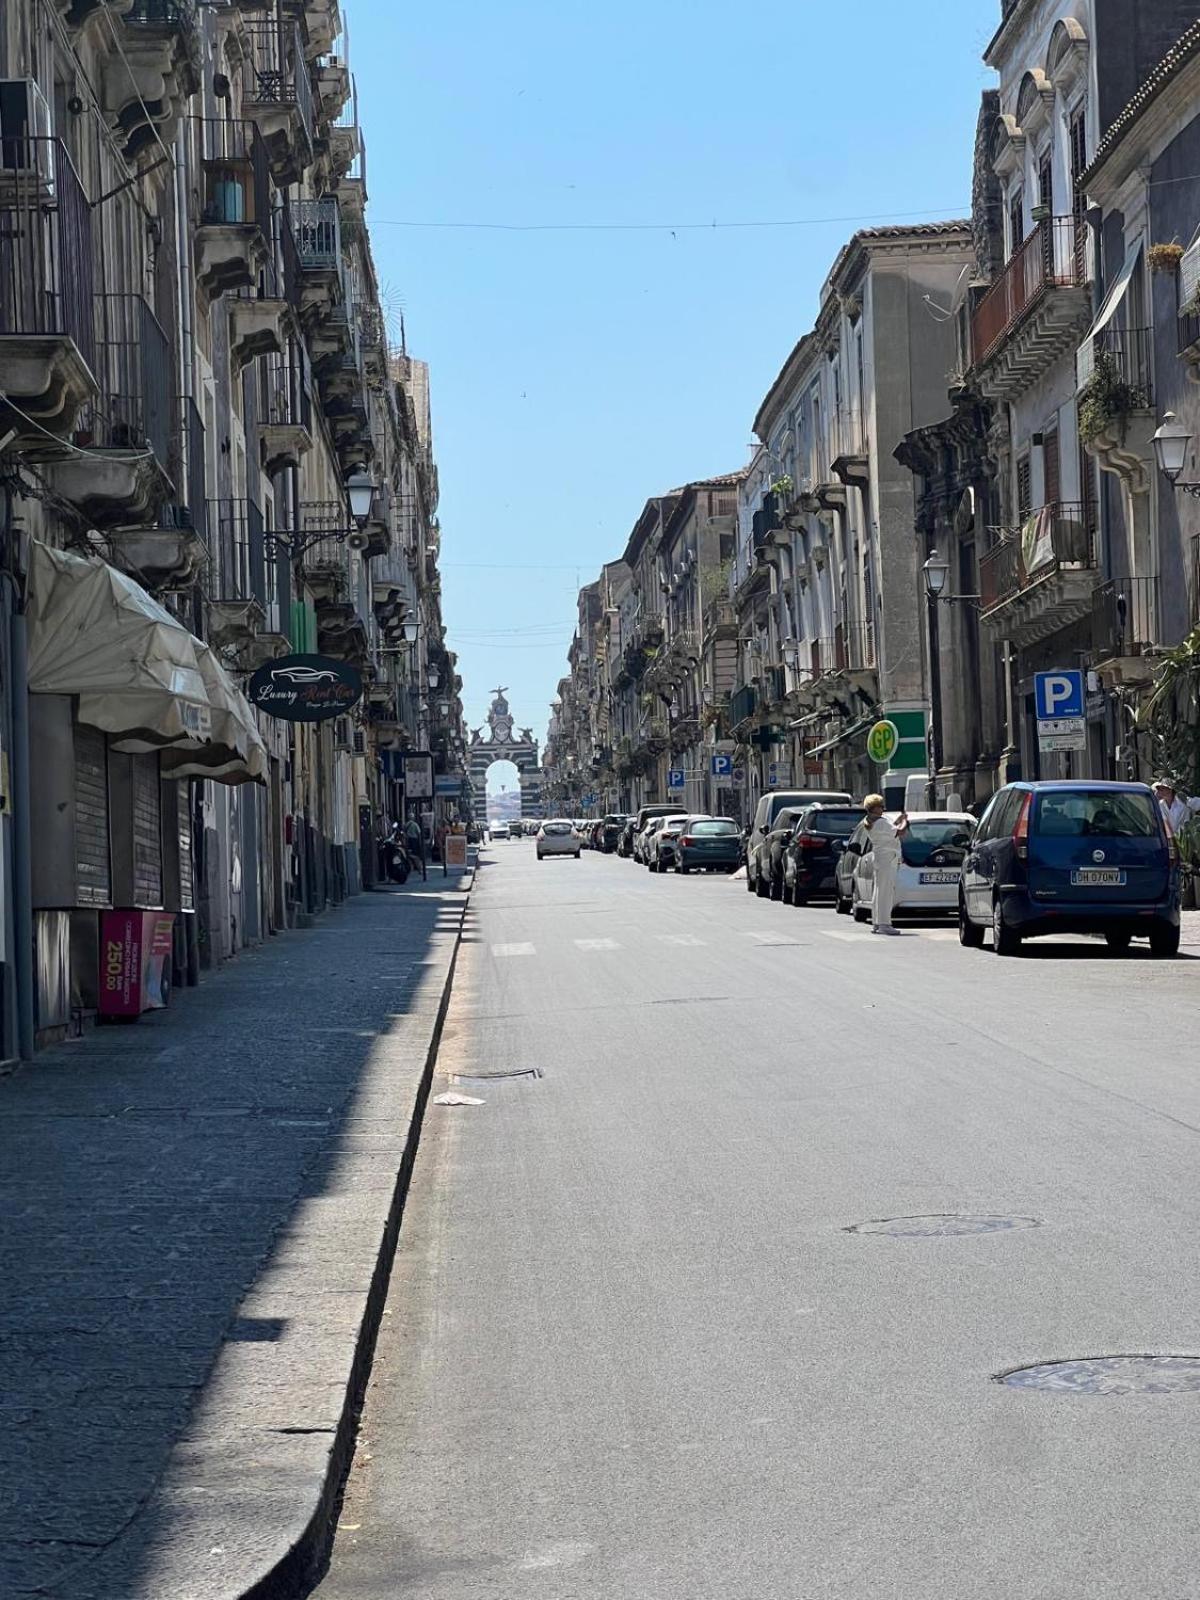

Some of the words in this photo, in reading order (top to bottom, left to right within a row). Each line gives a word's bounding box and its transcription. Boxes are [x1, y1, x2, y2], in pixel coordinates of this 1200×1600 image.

[257, 684, 297, 705] Luxury
[303, 684, 331, 700] Rent
[1044, 676, 1073, 715] P
[872, 729, 891, 752] GP
[714, 757, 727, 773] P
[671, 772, 681, 785] P
